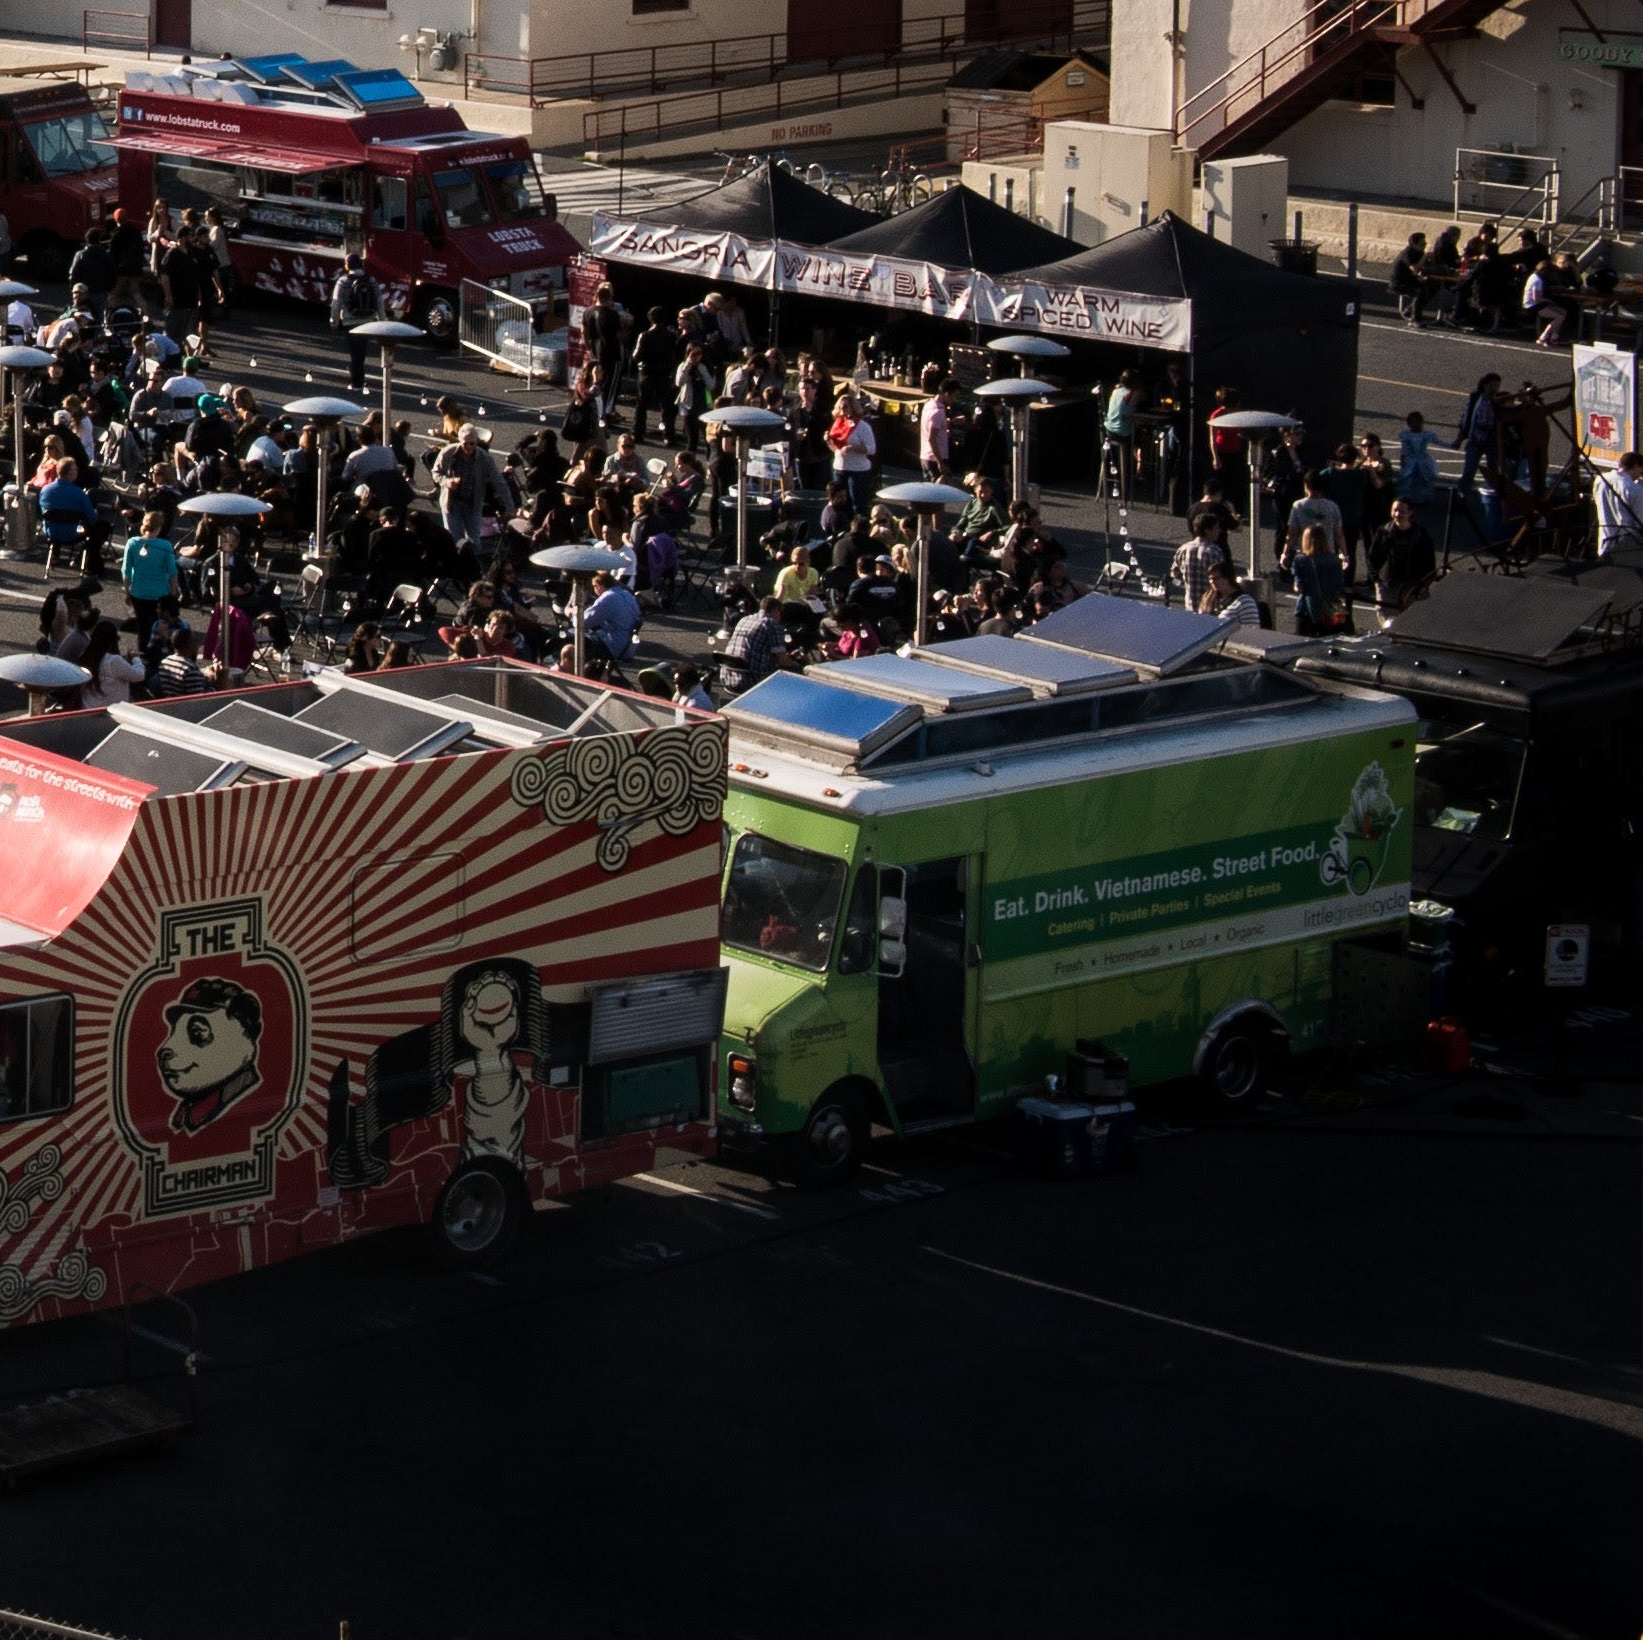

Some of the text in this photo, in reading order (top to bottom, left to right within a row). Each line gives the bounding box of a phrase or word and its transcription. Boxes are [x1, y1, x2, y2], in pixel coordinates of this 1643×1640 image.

[1560, 43, 1636, 64] GOODY
[145, 112, 241, 133] www.lobstatruck.com
[771, 123, 833, 141] NO PARKING
[487, 226, 535, 242] LOBSTA
[501, 239, 545, 254] TRUCK
[619, 229, 752, 272] SANGRIA
[780, 254, 872, 291] WINE
[1047, 288, 1120, 314] WARM
[1003, 305, 1163, 340] SPICED WINE
[24, 763, 44, 780] for
[44, 770, 64, 788] the
[64, 776, 106, 803] streets
[993, 840, 1321, 922] Eat. Drink. Vietnamese. Street Food.
[1047, 882, 1282, 938] Catering Private Parties Special Events
[186, 922, 236, 957] THE
[1054, 923, 1266, 976] Fresh Homemade Local Organic
[162, 1159, 256, 1195] CHAIRMAN
